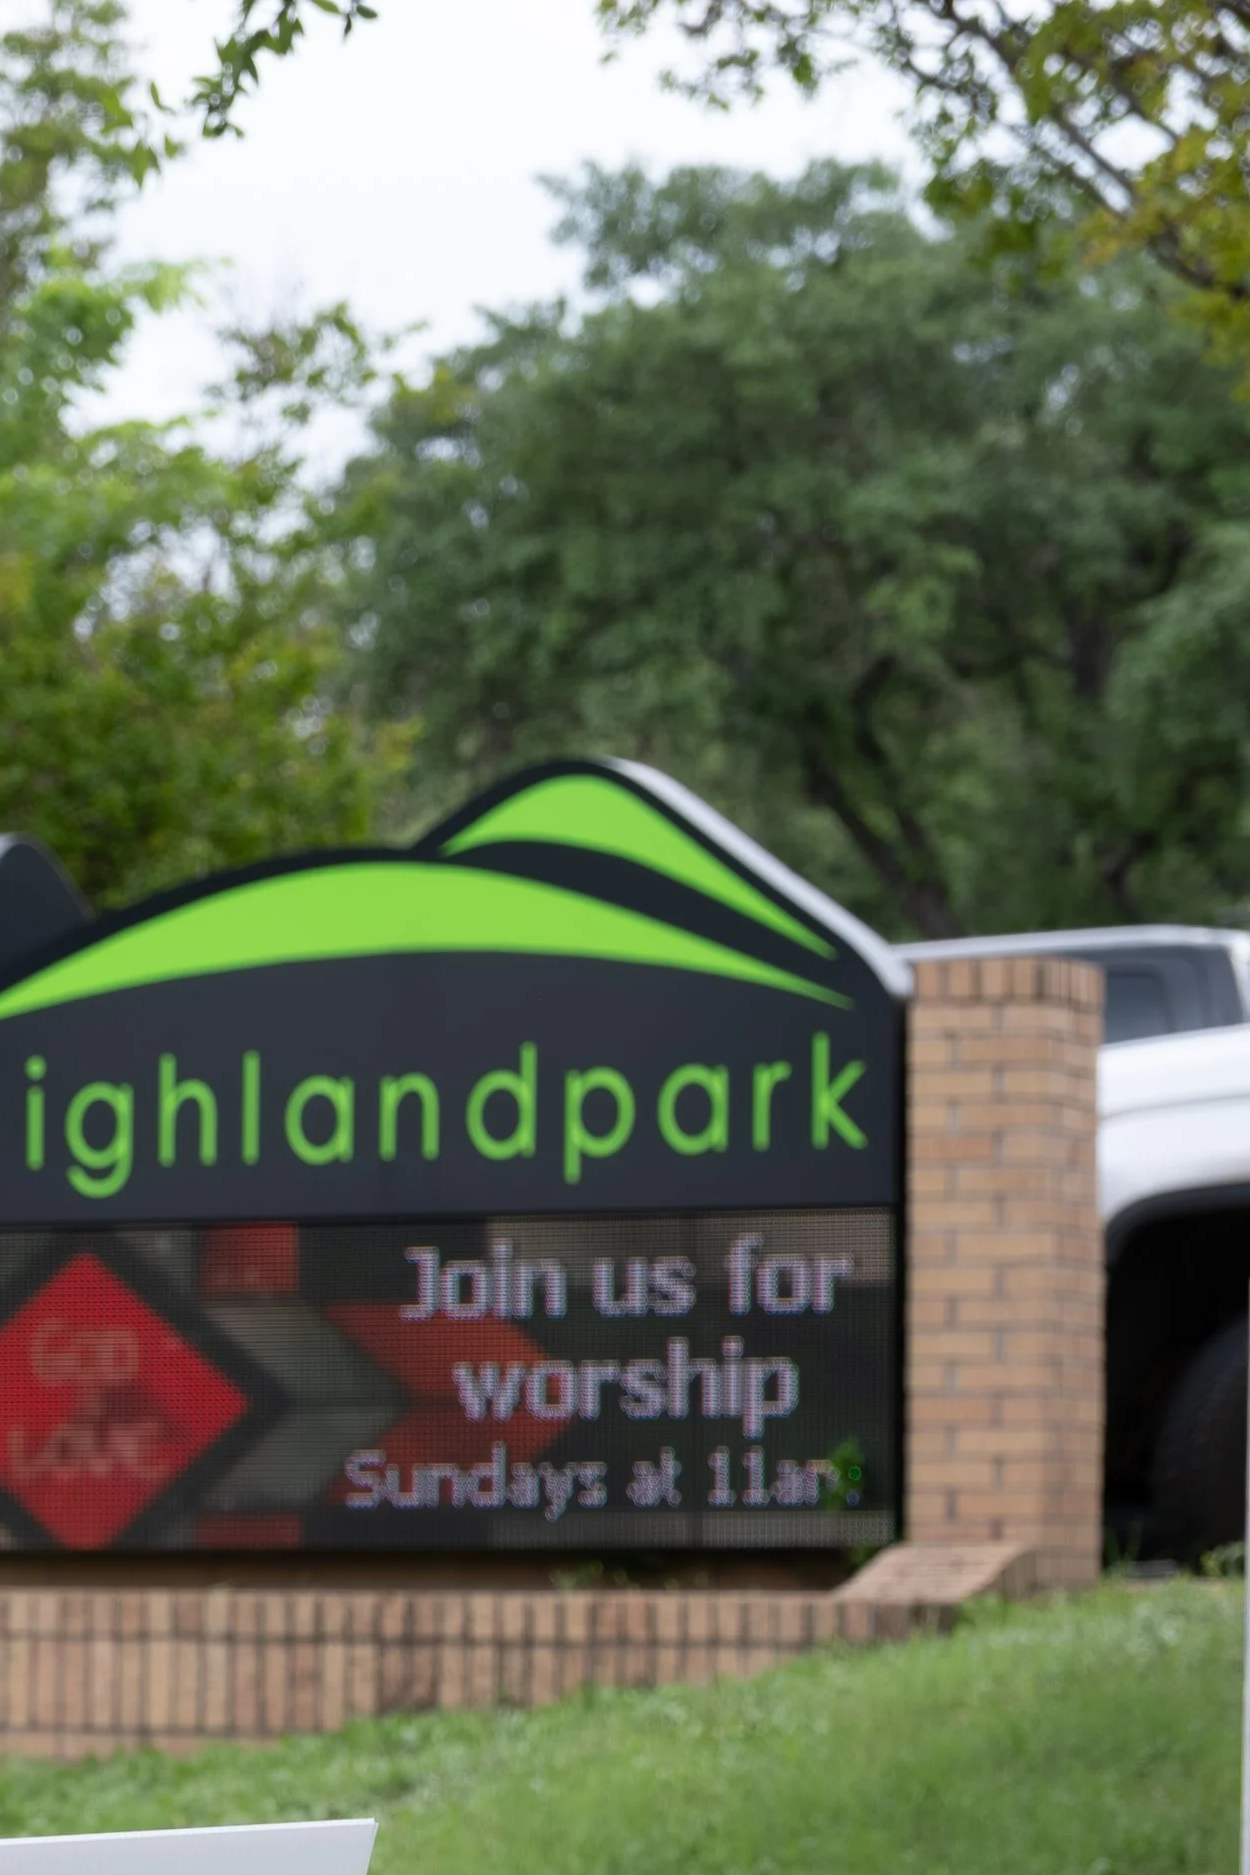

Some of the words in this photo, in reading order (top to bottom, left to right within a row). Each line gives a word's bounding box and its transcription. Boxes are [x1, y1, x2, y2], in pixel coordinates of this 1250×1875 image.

[400, 1237, 567, 1320] Join
[593, 1256, 696, 1317] us
[726, 1232, 854, 1317] for
[453, 1336, 800, 1438] worship
[346, 1441, 607, 1522] Sundays
[627, 1446, 682, 1507] at
